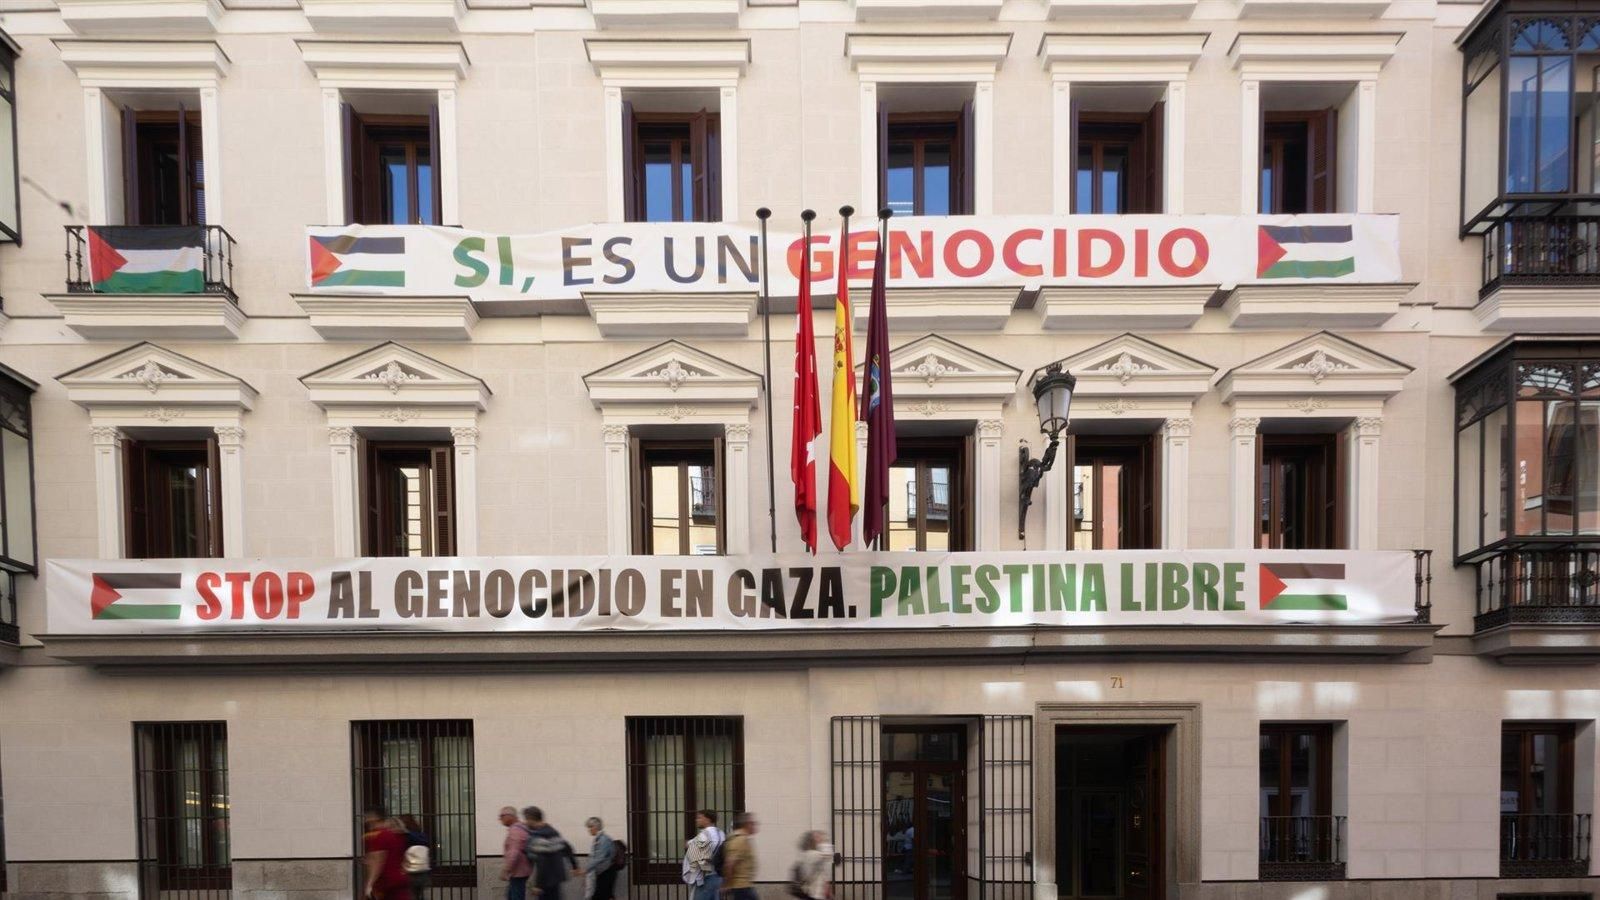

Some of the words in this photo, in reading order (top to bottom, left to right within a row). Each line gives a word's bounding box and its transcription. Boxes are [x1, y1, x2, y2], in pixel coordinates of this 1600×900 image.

[454, 235, 534, 294] SI,
[562, 236, 634, 286] ES
[664, 234, 759, 286] UN
[786, 228, 1209, 282] GENOCIDIO
[196, 571, 315, 620] STOP
[327, 570, 380, 618] AL
[395, 568, 647, 618] GENOCIDIO
[660, 569, 713, 617] EN
[727, 566, 857, 619] GAZA.
[869, 562, 1108, 617] PALESTINA
[1120, 561, 1246, 611] LIBRE
[1110, 676, 1124, 689] 71
